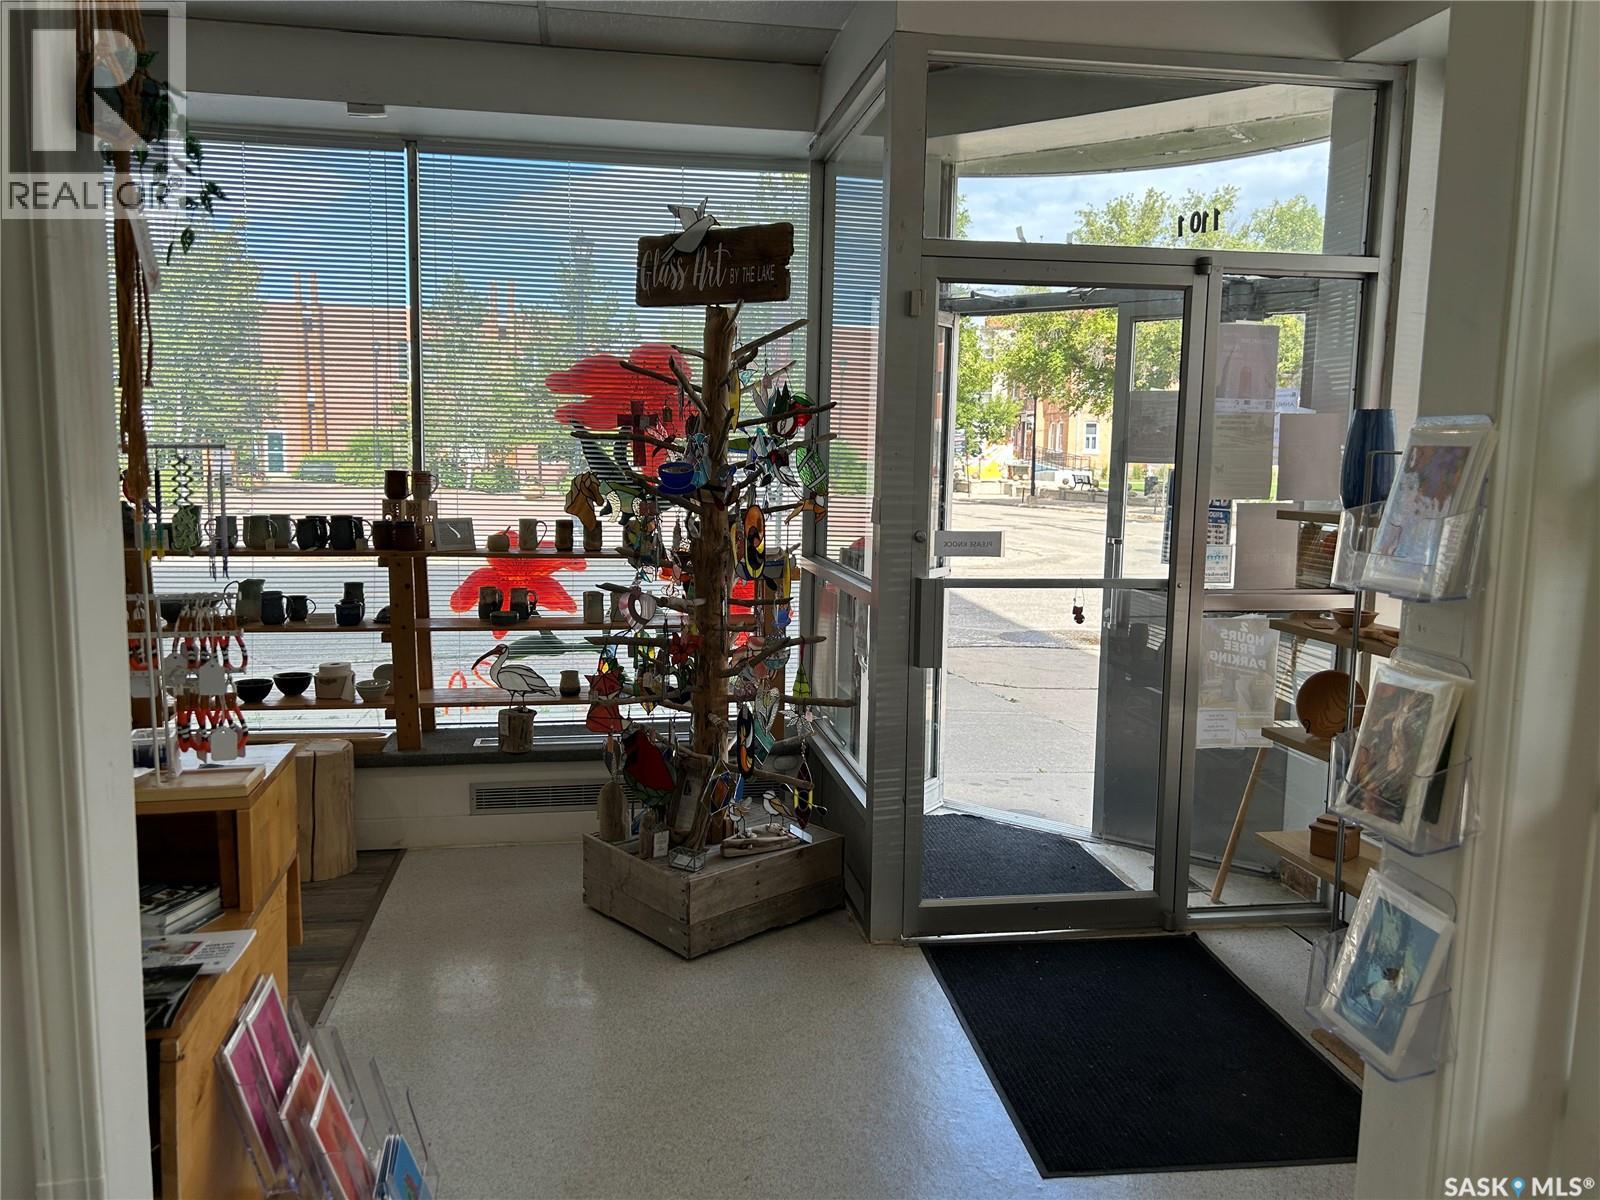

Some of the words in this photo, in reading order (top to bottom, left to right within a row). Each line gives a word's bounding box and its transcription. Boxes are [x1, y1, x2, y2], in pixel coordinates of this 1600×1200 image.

[640, 247, 688, 297] Glass
[693, 242, 732, 292] Art
[729, 267, 740, 285] BY
[742, 266, 756, 283] THE
[757, 264, 776, 282] LAKE
